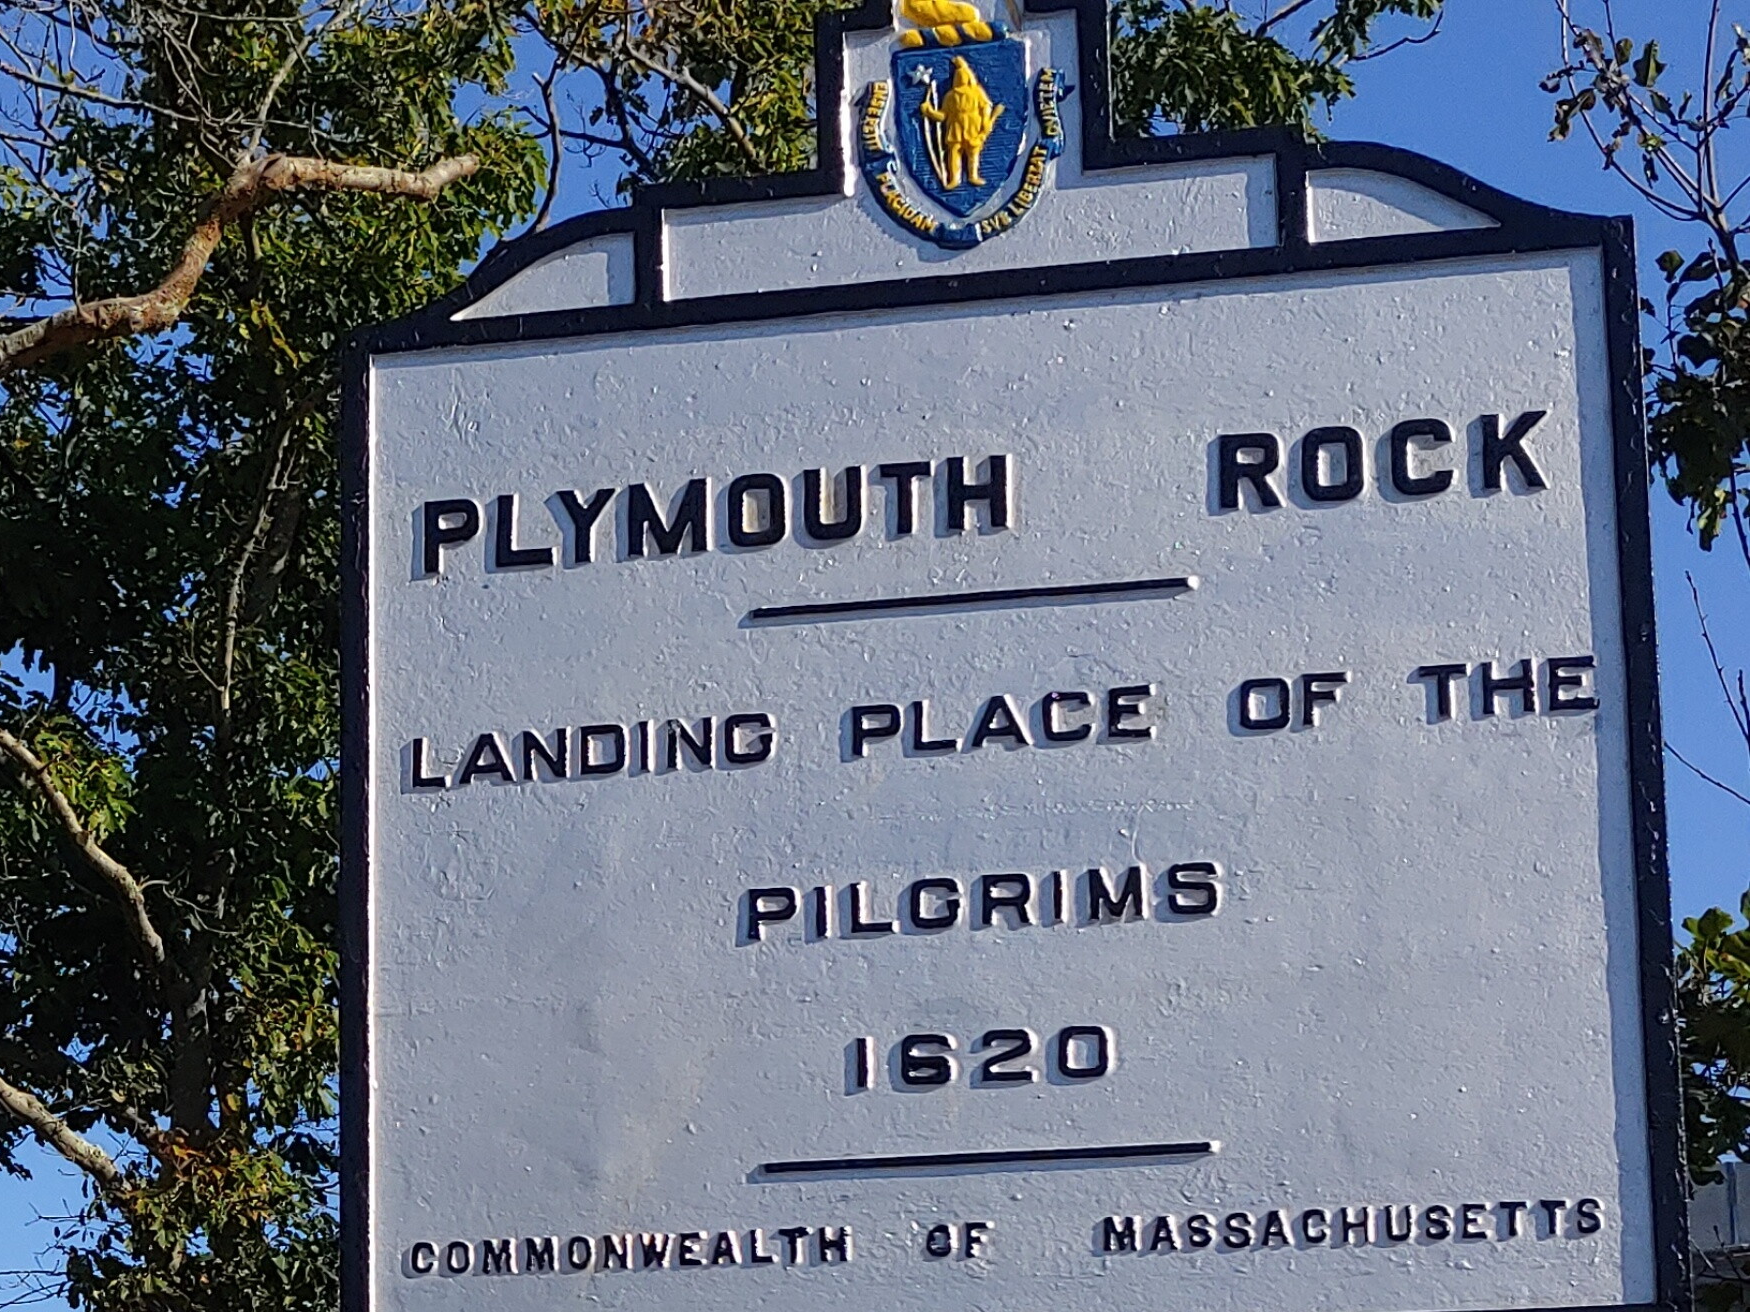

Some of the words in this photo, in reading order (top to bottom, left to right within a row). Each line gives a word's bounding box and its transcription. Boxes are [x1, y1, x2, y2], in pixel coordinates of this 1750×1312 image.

[875, 172, 939, 233] PLACIDAM
[417, 453, 1013, 577] PLYMOUTH
[1213, 409, 1550, 512] ROCK
[406, 711, 776, 791] LANDING
[845, 684, 1155, 759] PLACE
[1233, 671, 1352, 732] OF
[1412, 655, 1600, 722] THE
[743, 861, 1222, 944] PILGRIMS
[850, 1025, 1116, 1091] 1620
[405, 1225, 852, 1277] COMMONWEALTH
[924, 1220, 996, 1261] OF
[1097, 1198, 1606, 1254] MASSACHUSETTS
